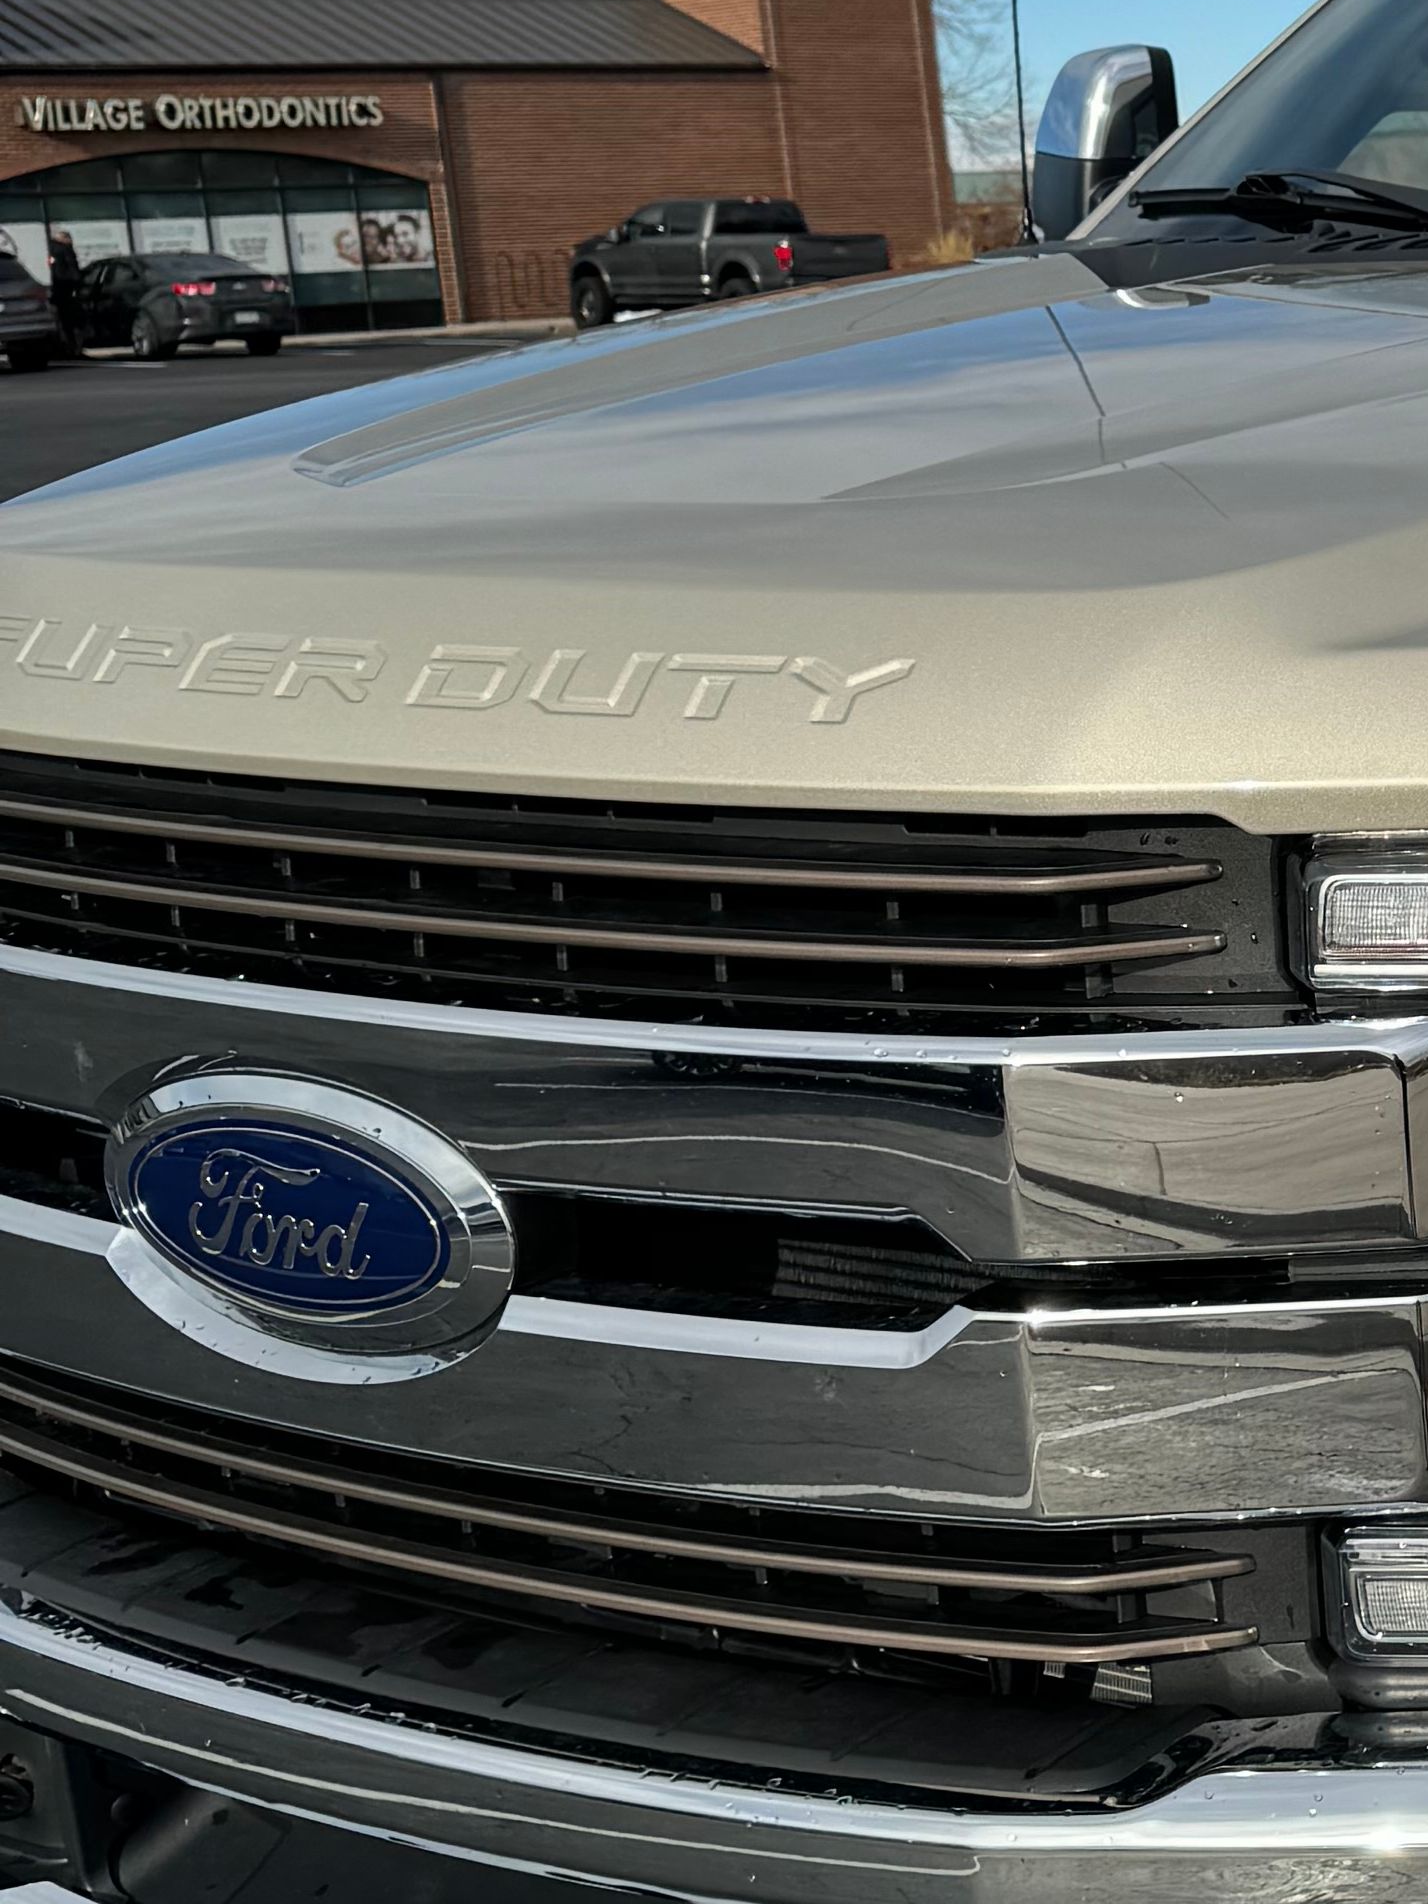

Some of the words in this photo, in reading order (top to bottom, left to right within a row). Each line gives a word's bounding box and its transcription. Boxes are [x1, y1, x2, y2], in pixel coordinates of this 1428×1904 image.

[20, 95, 145, 132] VILLAGE
[155, 94, 384, 130] ORTHODONTICS
[405, 643, 917, 724] DUTY
[187, 1148, 373, 1281] Ford
